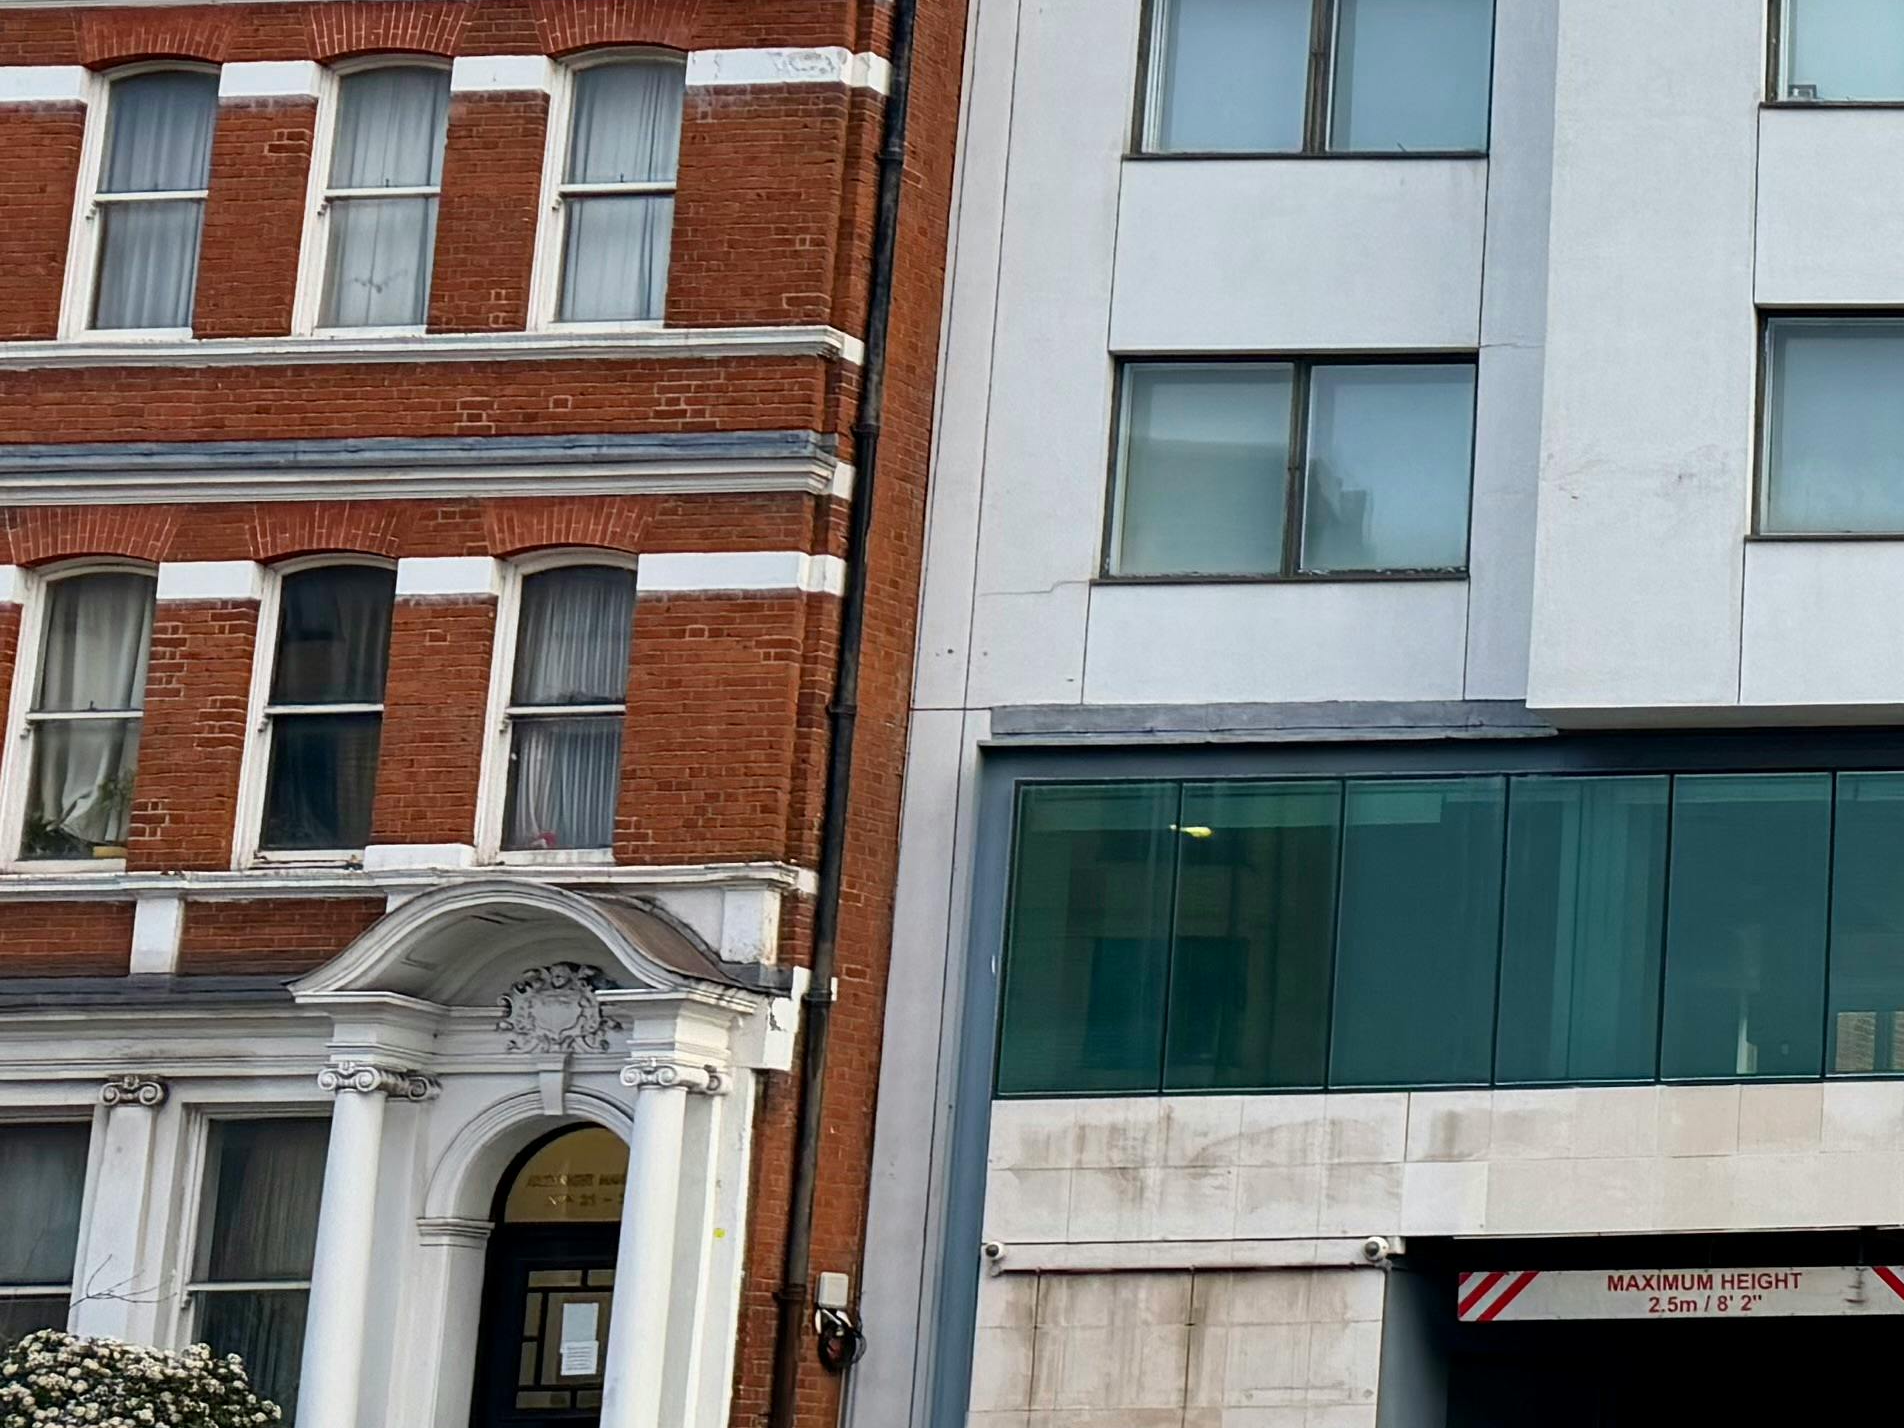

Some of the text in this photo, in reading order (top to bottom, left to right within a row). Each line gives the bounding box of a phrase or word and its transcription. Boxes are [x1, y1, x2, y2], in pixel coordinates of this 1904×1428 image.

[1607, 1272, 1803, 1292] MAXIMUM HEIGHT
[1648, 1296, 1698, 1314] 2.5m
[1716, 1295, 1734, 1313] 8'
